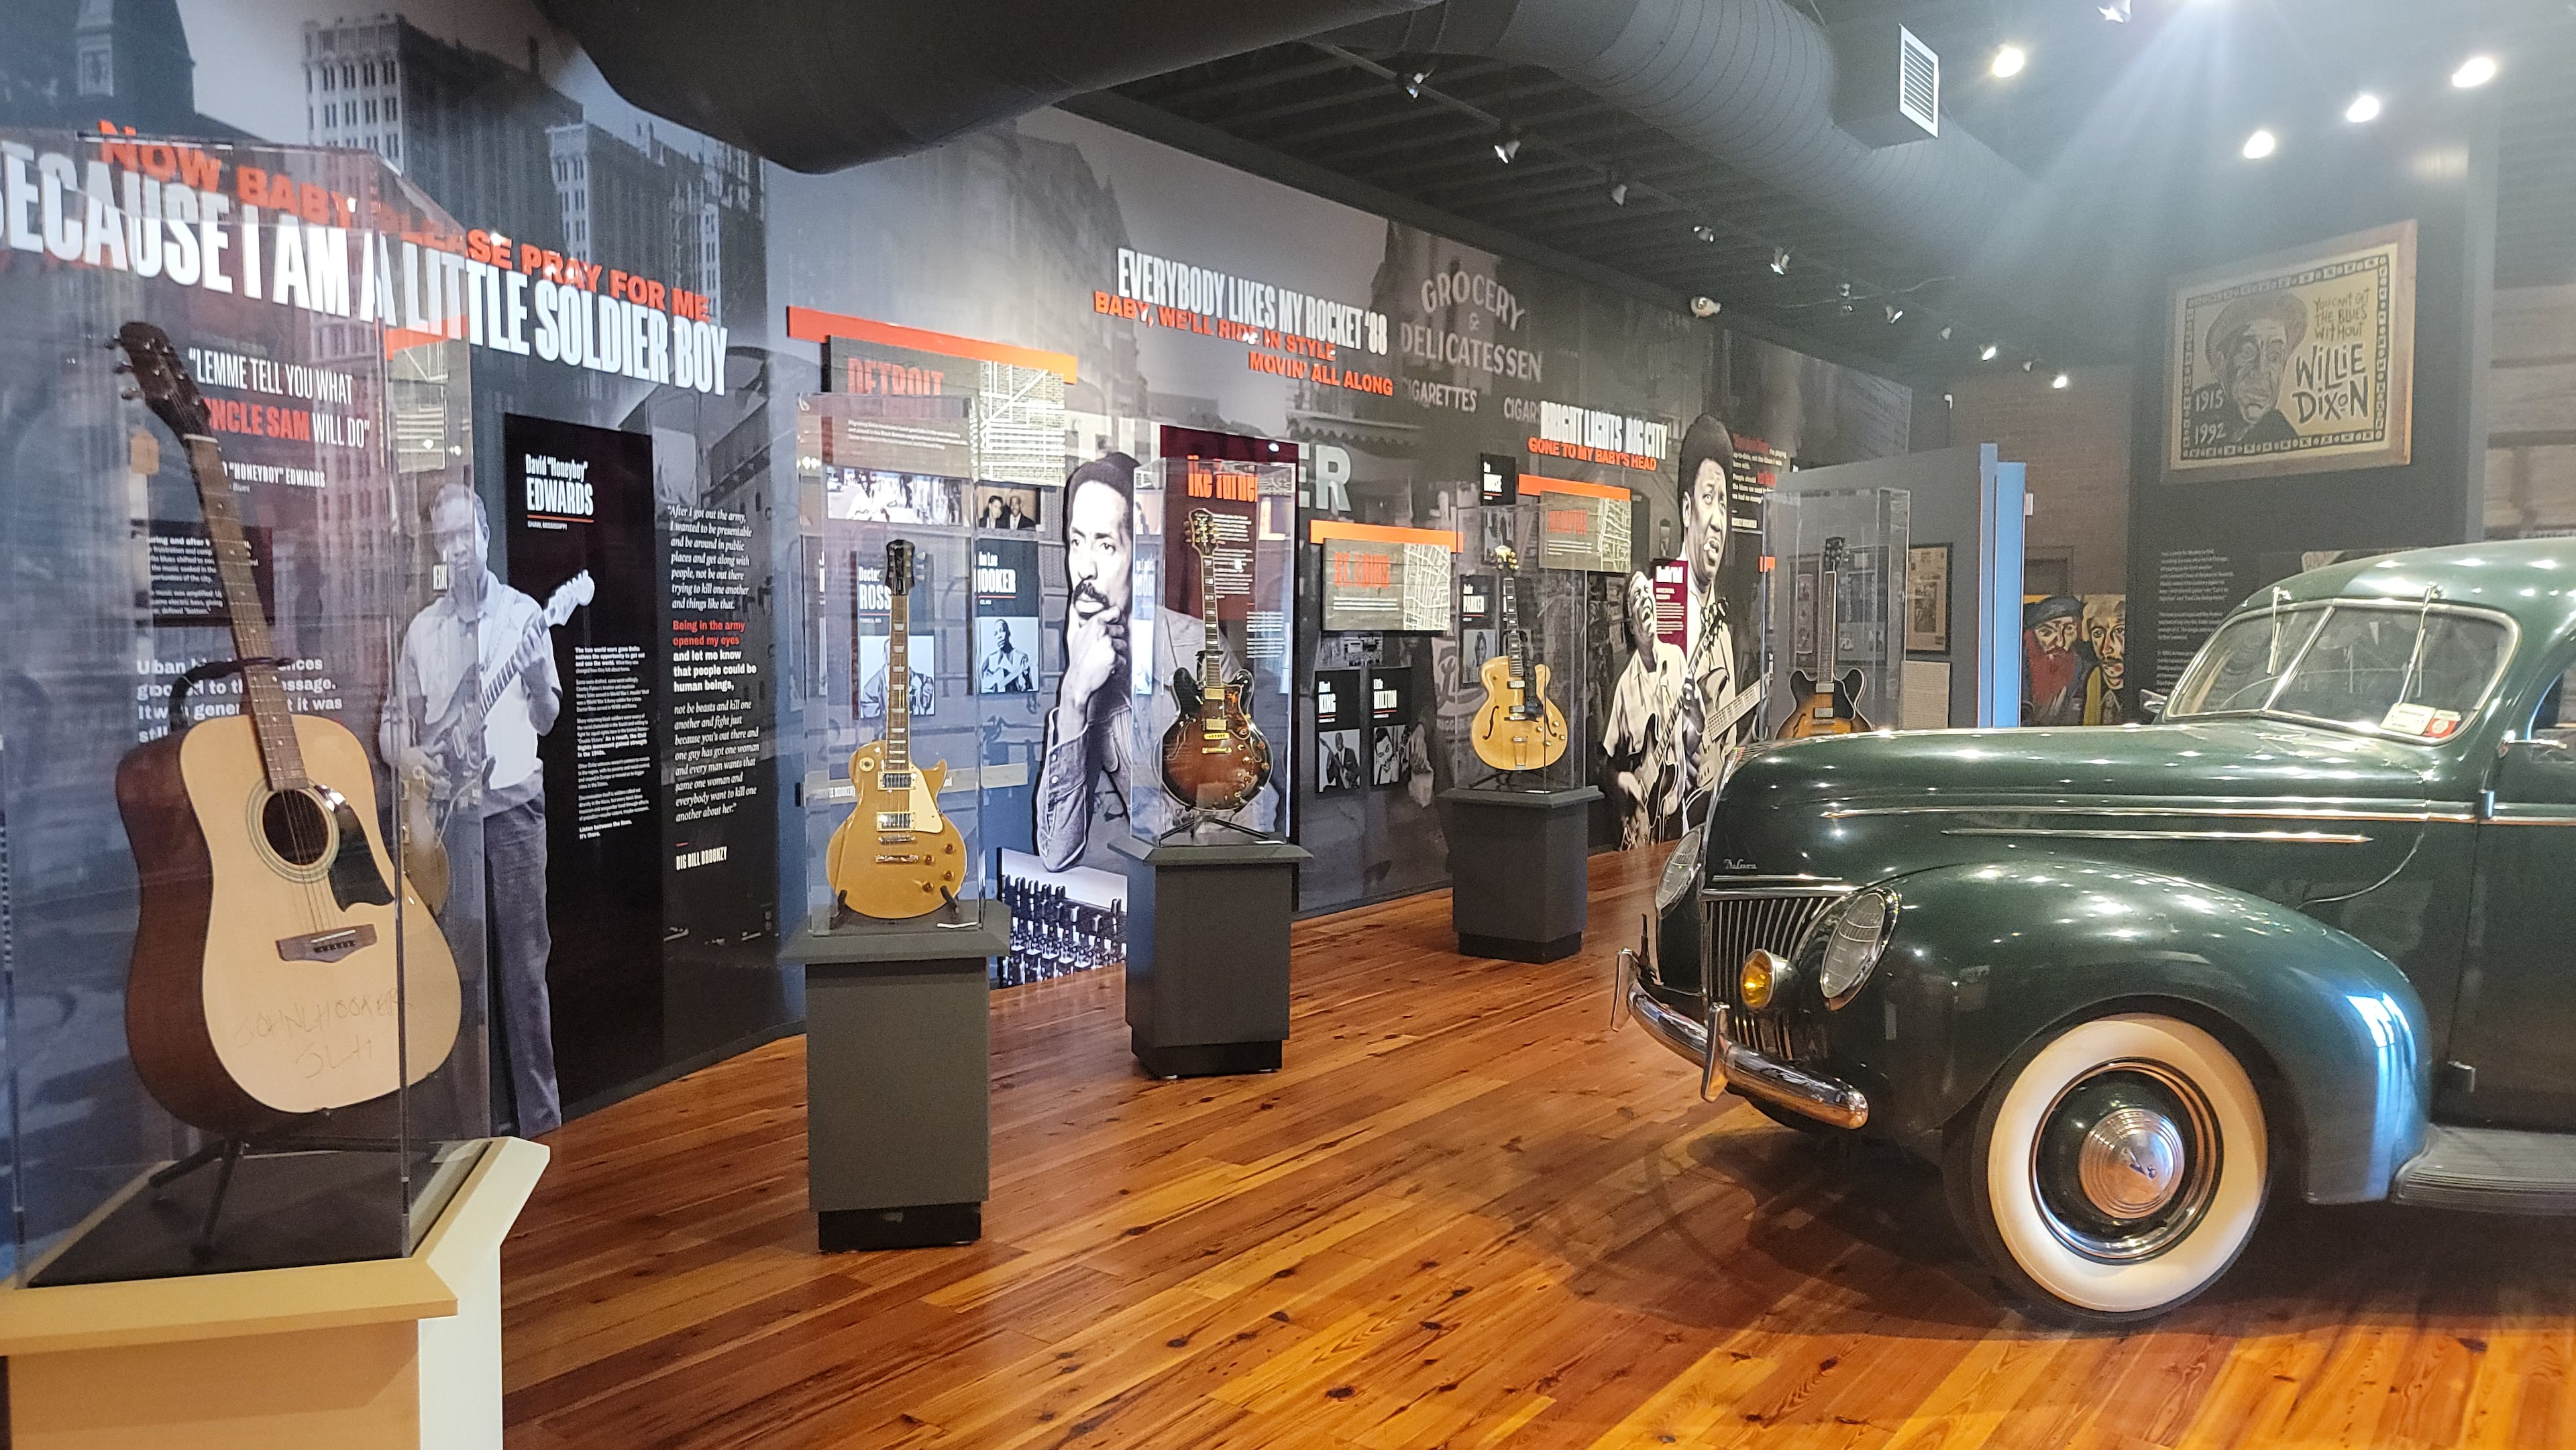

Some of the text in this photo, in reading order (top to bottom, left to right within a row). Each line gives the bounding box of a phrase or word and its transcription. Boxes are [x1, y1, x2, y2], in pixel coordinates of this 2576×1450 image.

[98, 119, 222, 192] NOW
[237, 166, 355, 228] BABY
[521, 243, 602, 292] PRAY
[610, 269, 665, 310] FOR
[672, 287, 710, 323] ME
[0, 140, 729, 396] ECAUSE I AM A LITTLE SOLDIER BOY
[1118, 247, 1226, 319] EVERYBODY
[1228, 276, 1275, 331] LIKES
[1279, 288, 1304, 336] MY
[1305, 295, 1363, 350] ROCKET
[1421, 270, 1525, 331] GROCERY
[1093, 290, 1336, 361] BABY, WE'LL RIDE IN STYLE
[1400, 322, 1543, 384] DELICATESSEN
[250, 357, 284, 395] TELL
[285, 363, 313, 400] YOU
[315, 368, 353, 405] WHAT
[847, 356, 945, 396] DETROIT
[1248, 350, 1394, 397] MOVIN' ALL ALONG
[2195, 389, 2224, 413] 1915
[266, 405, 311, 441] SAM
[312, 411, 345, 447] WILL
[1540, 400, 1668, 460] BRIGHT LIGHTS BIG CITY
[2194, 421, 2226, 445] 1992
[1527, 436, 1658, 471] GONE TO MY BABY'S HEAD
[525, 453, 547, 476] David
[286, 467, 325, 488] EDWARDS
[526, 476, 594, 516] EDWARDS
[693, 509, 705, 520] got
[705, 510, 716, 520] out
[717, 508, 728, 520] the
[675, 521, 700, 533] wanted
[700, 523, 708, 534] to
[708, 522, 716, 535] be
[716, 525, 753, 537] presentable
[671, 535, 745, 553] and be around in public
[696, 569, 707, 579] not
[708, 567, 716, 580] be
[716, 570, 727, 580] out
[728, 568, 745, 581] there
[859, 583, 892, 610] ROSS
[1462, 595, 1485, 613] PARKER
[672, 619, 745, 633] Being in the army
[673, 634, 740, 648] opened my eyes
[673, 649, 742, 662] and let me know
[673, 663, 757, 679] that people could be
[209, 679, 227, 695] to
[674, 678, 735, 693] human beings,
[297, 697, 342, 712] it was
[674, 698, 752, 715] not be beasts and kill one
[1318, 692, 1336, 714] KING
[1373, 689, 1397, 710] MILTON
[674, 714, 743, 730] another and fight just
[674, 733, 701, 746] because
[718, 730, 730, 741] out
[730, 728, 747, 740] there
[747, 726, 759, 738] and
[674, 743, 759, 762] one guy has got one woman
[676, 808, 702, 822] another
[702, 805, 722, 818] about
